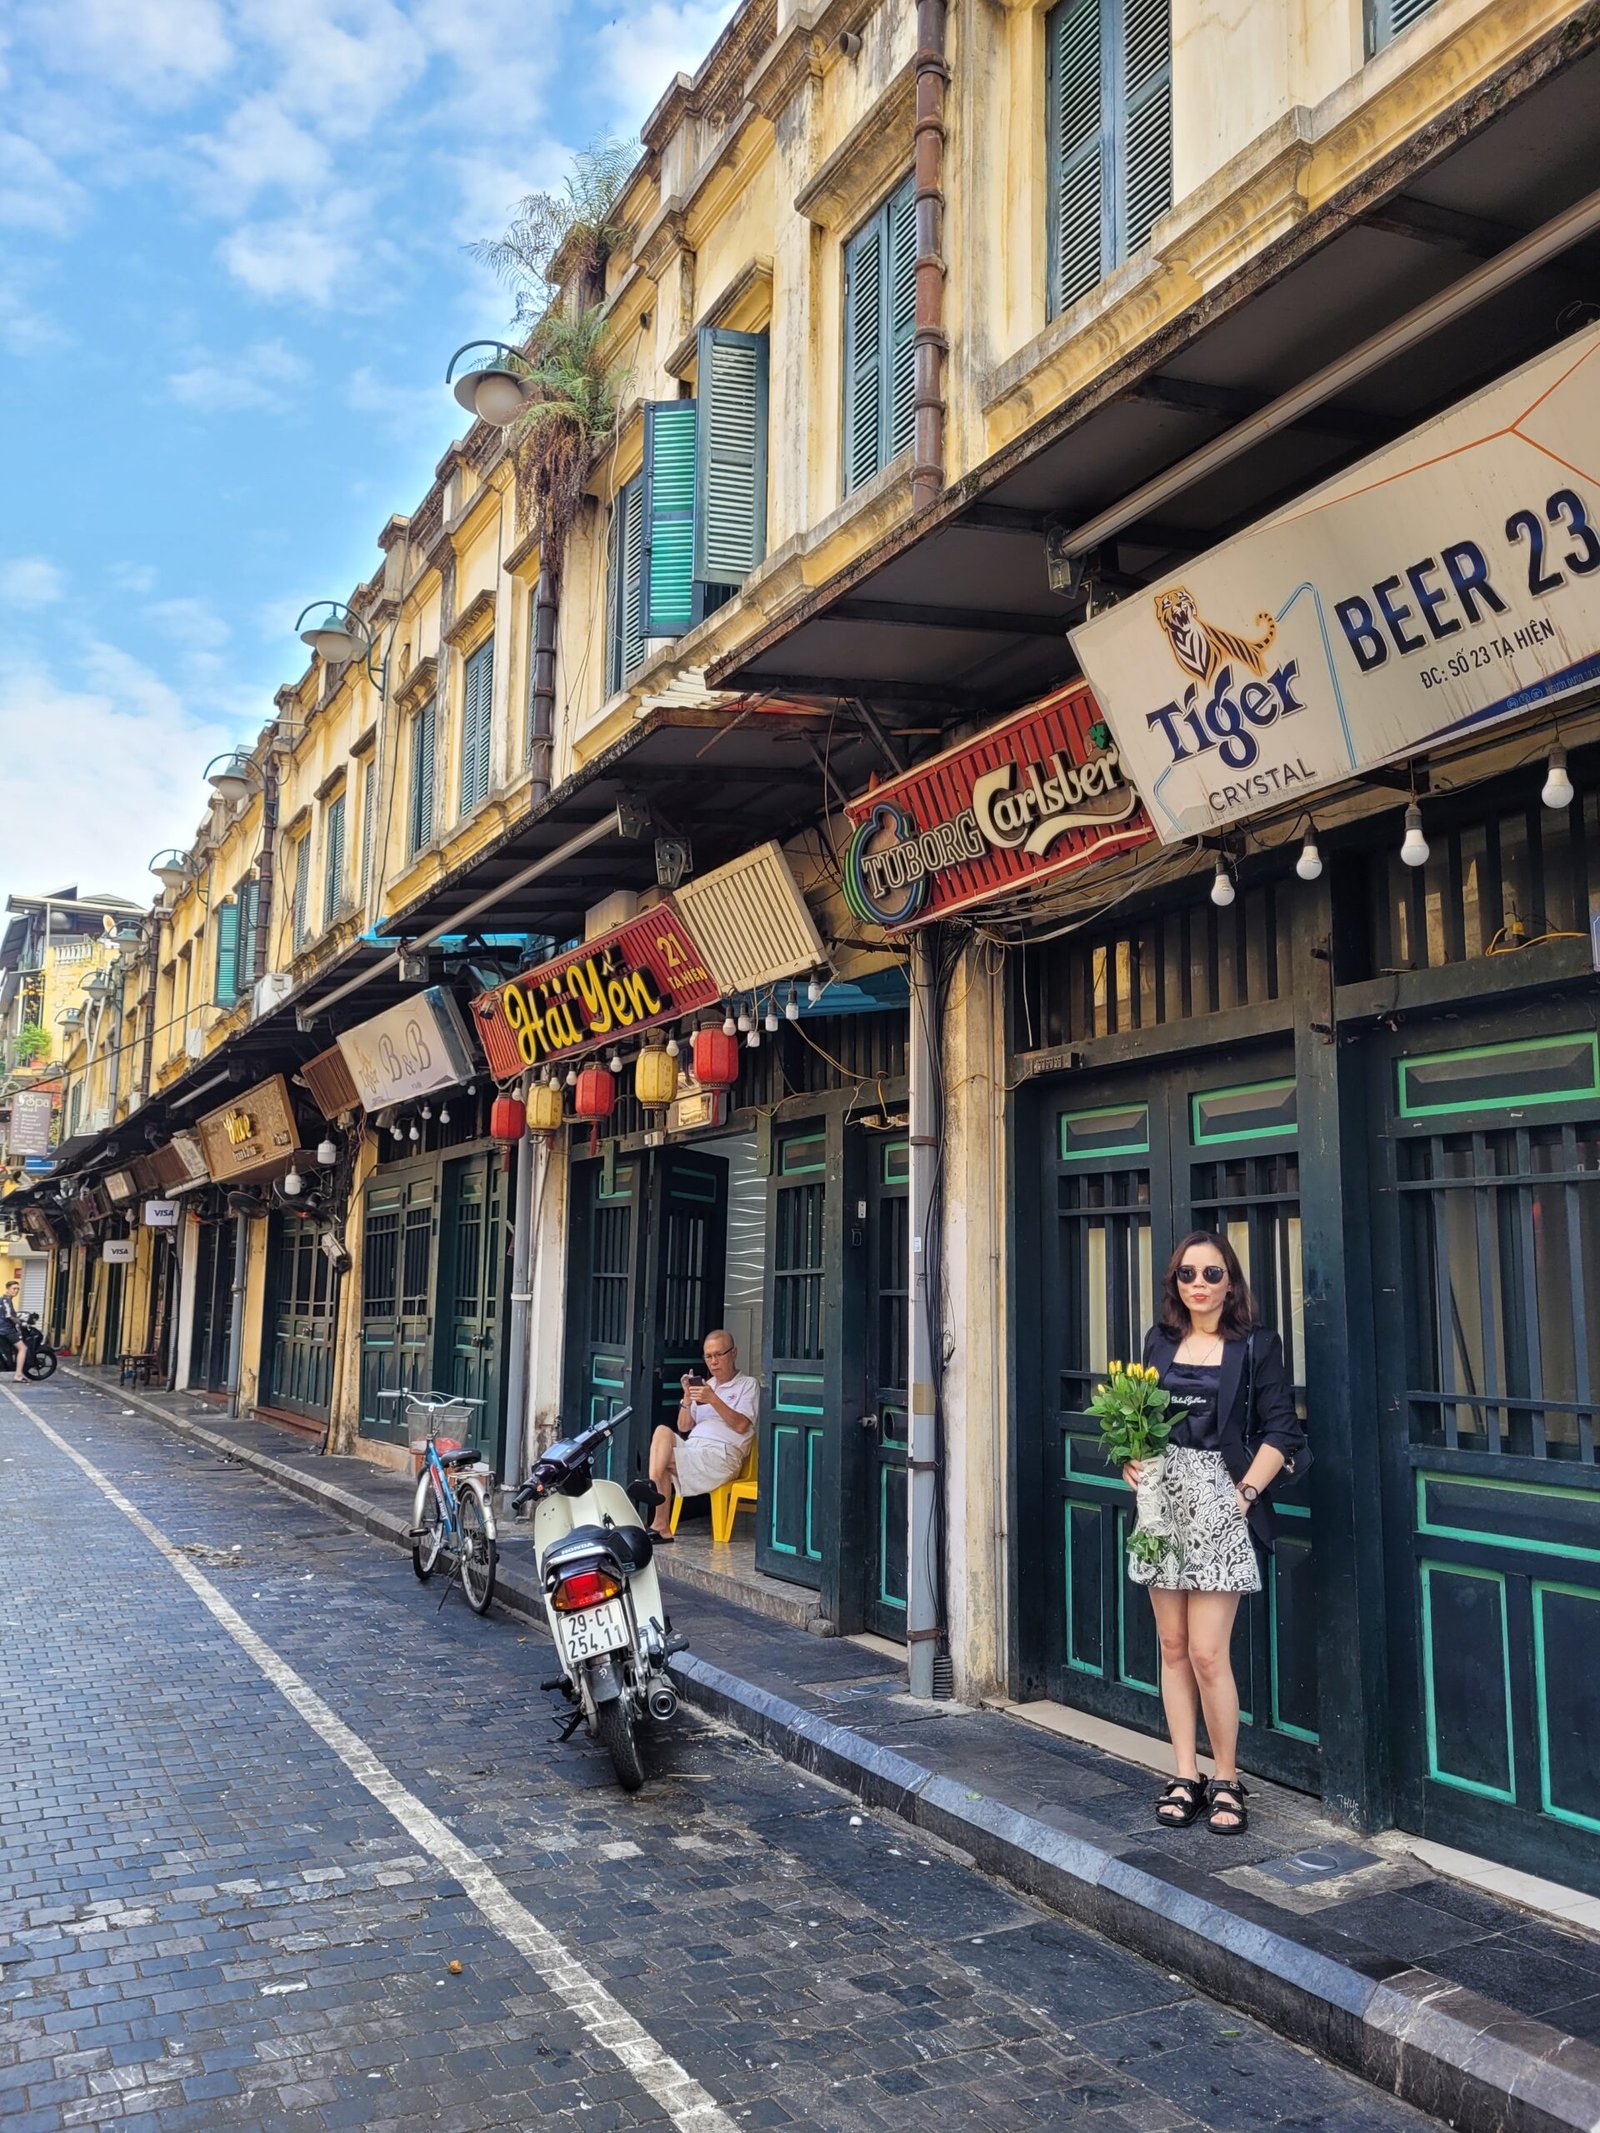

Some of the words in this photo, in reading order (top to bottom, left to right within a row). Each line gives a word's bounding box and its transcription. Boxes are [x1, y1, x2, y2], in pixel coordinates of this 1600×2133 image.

[1334, 540, 1509, 673] BEER
[1504, 487, 1600, 597] 23
[1419, 666, 1449, 690] ĐC:
[1447, 648, 1471, 678] SỐ
[1469, 645, 1492, 669] 23
[1489, 636, 1516, 659] TẠ
[1513, 617, 1556, 650] HIỆN
[1145, 659, 1306, 770] Tiger
[1208, 758, 1317, 812] CRYSTAL
[861, 806, 986, 899] TUBORG
[656, 931, 689, 968] 21
[154, 1209, 175, 1217] VISA
[561, 1542, 595, 1555] HONDA
[568, 1604, 614, 1637] 29-C1
[568, 1624, 623, 1660] 254.11
